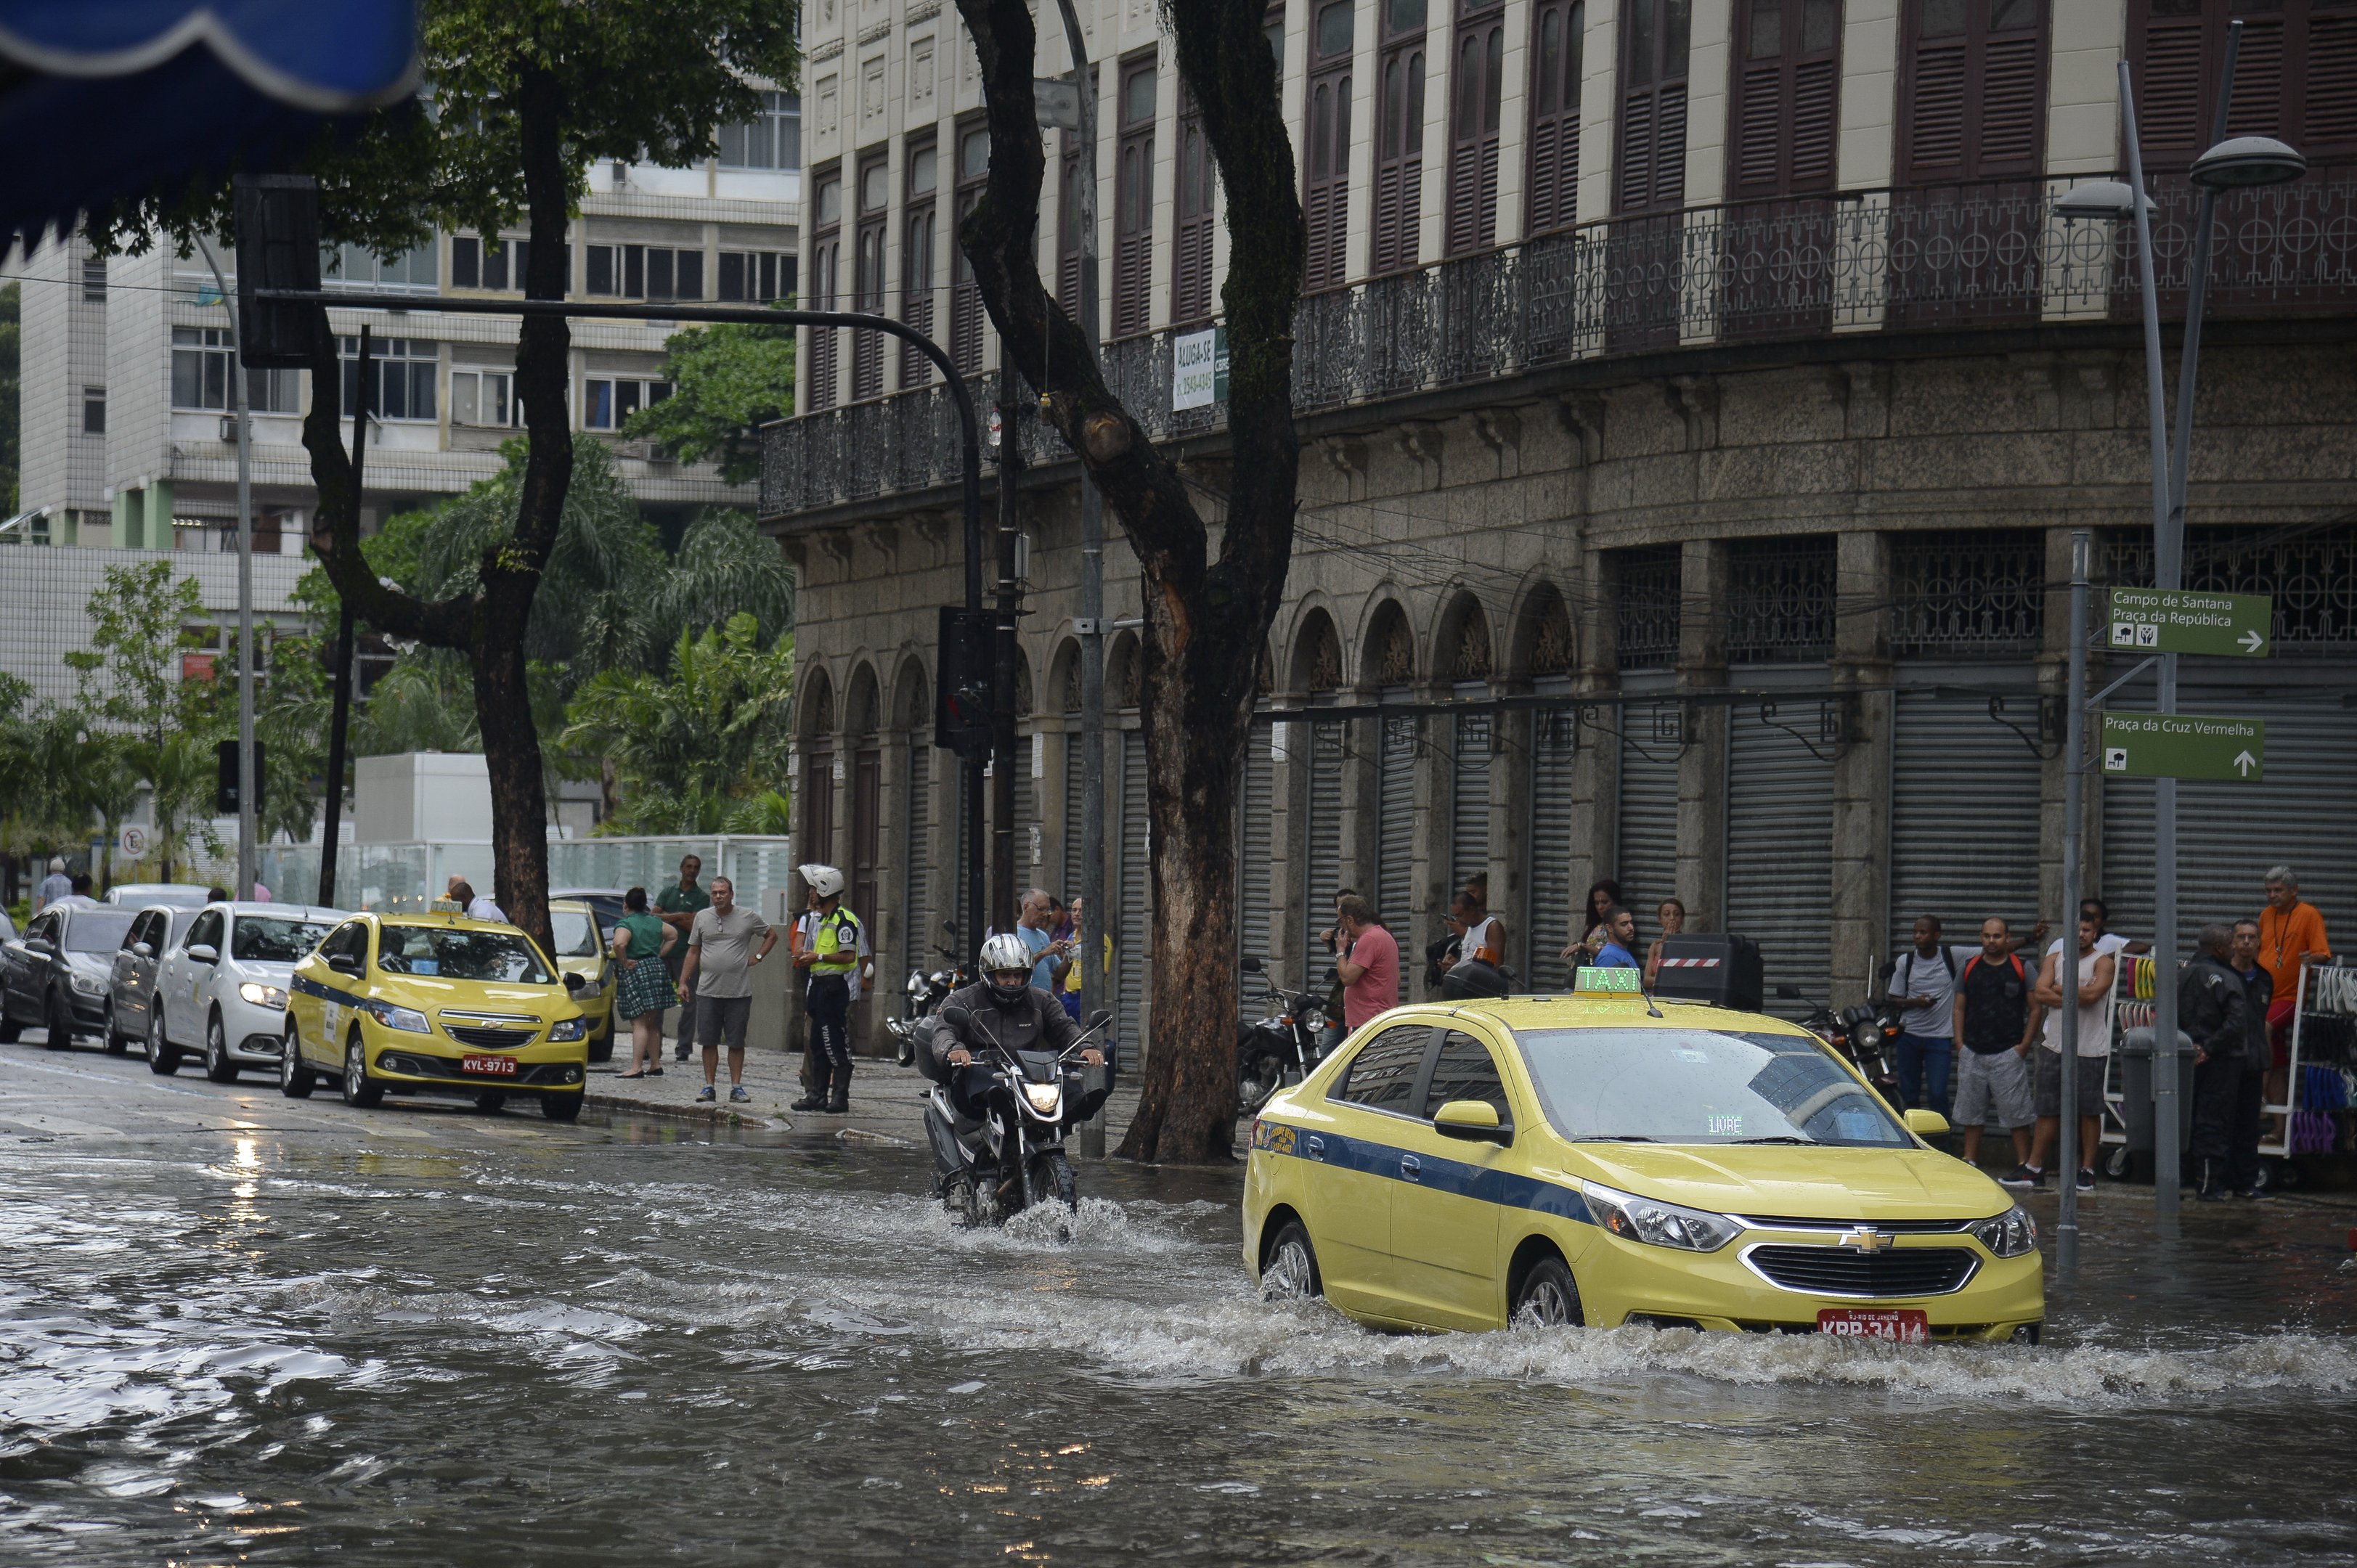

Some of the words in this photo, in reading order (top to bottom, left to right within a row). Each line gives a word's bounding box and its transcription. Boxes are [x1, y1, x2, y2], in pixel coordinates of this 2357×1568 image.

[1178, 340, 1211, 369] ALUGA-SE
[2114, 592, 2159, 608] Campo
[2162, 595, 2178, 607] de
[2182, 596, 2232, 611] Santana
[2113, 608, 2146, 624] Praça
[2150, 611, 2165, 623] da
[2170, 612, 2231, 627] República
[2106, 717, 2139, 732] Praça
[2143, 719, 2158, 732] da
[2162, 720, 2191, 734] Cruz
[2194, 722, 2254, 737] Vermelha
[1579, 969, 1637, 991] TAXI
[464, 1060, 514, 1072] KYL-9713
[1709, 1119, 1742, 1133] LIVRE
